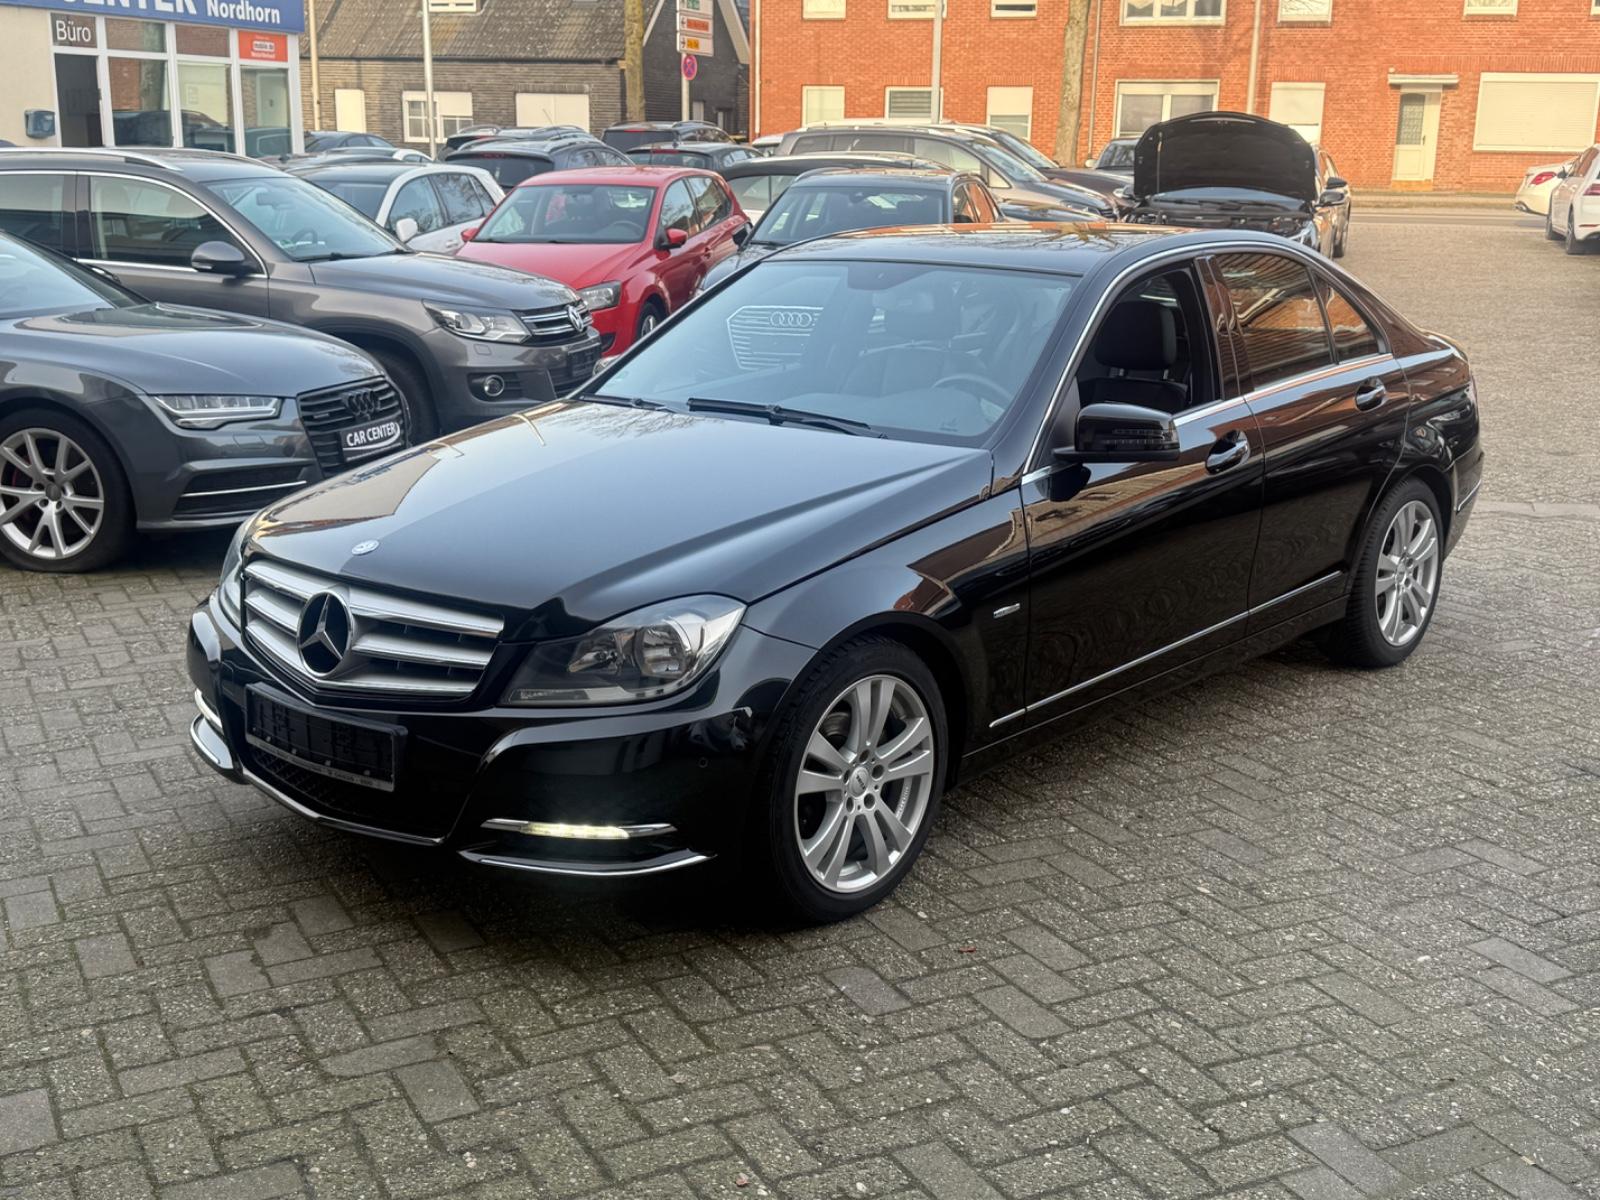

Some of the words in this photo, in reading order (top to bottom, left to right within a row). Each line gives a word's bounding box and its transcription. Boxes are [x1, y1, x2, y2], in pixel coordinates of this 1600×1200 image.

[206, 0, 280, 24] Nordhorn
[56, 20, 91, 42] Büro
[346, 430, 367, 446] CAR
[366, 422, 396, 441] CENTER
